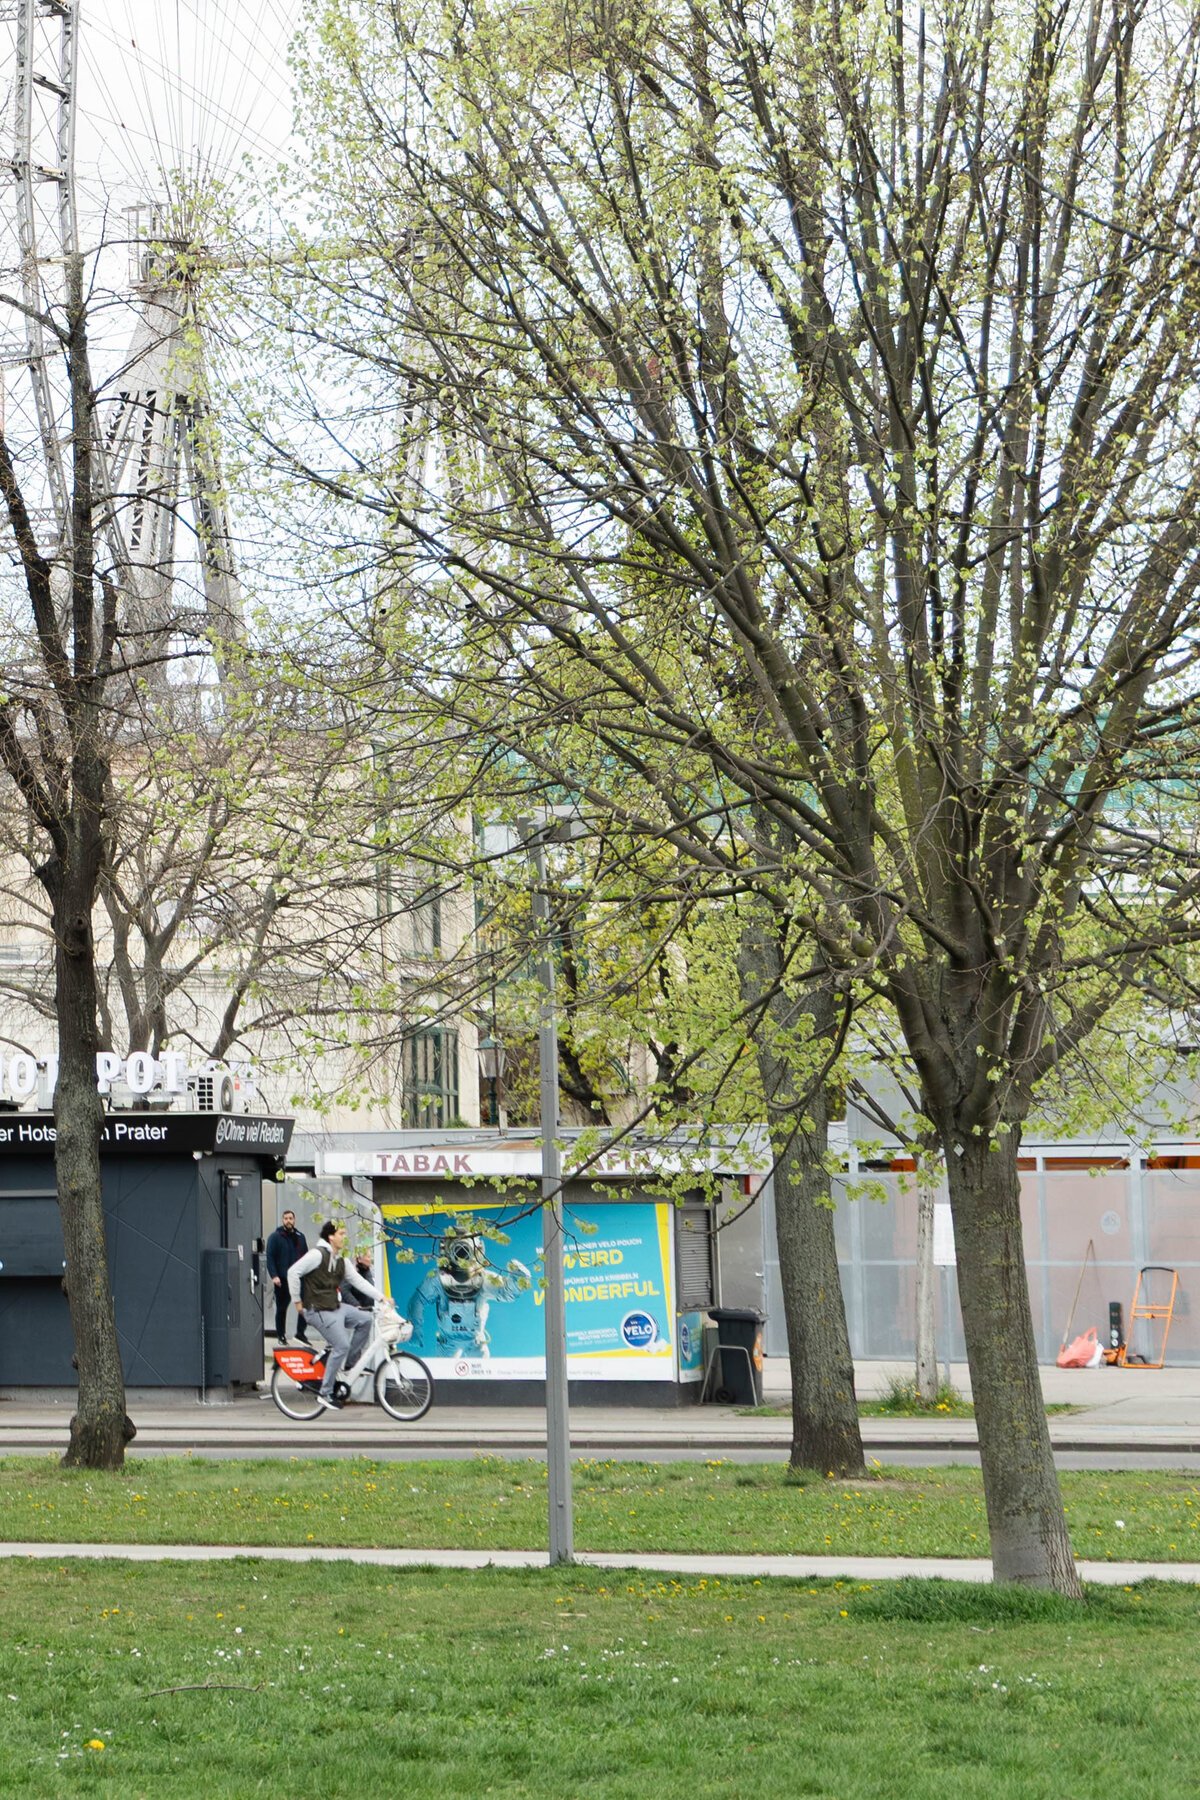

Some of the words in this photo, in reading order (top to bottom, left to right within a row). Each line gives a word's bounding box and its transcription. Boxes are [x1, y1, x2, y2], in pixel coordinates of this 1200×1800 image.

[115, 1123, 168, 1140] Prater
[225, 1120, 245, 1142] Ohne
[247, 1121, 261, 1142] viel
[377, 1154, 473, 1172] TABAK
[624, 1325, 652, 1336] VELO
